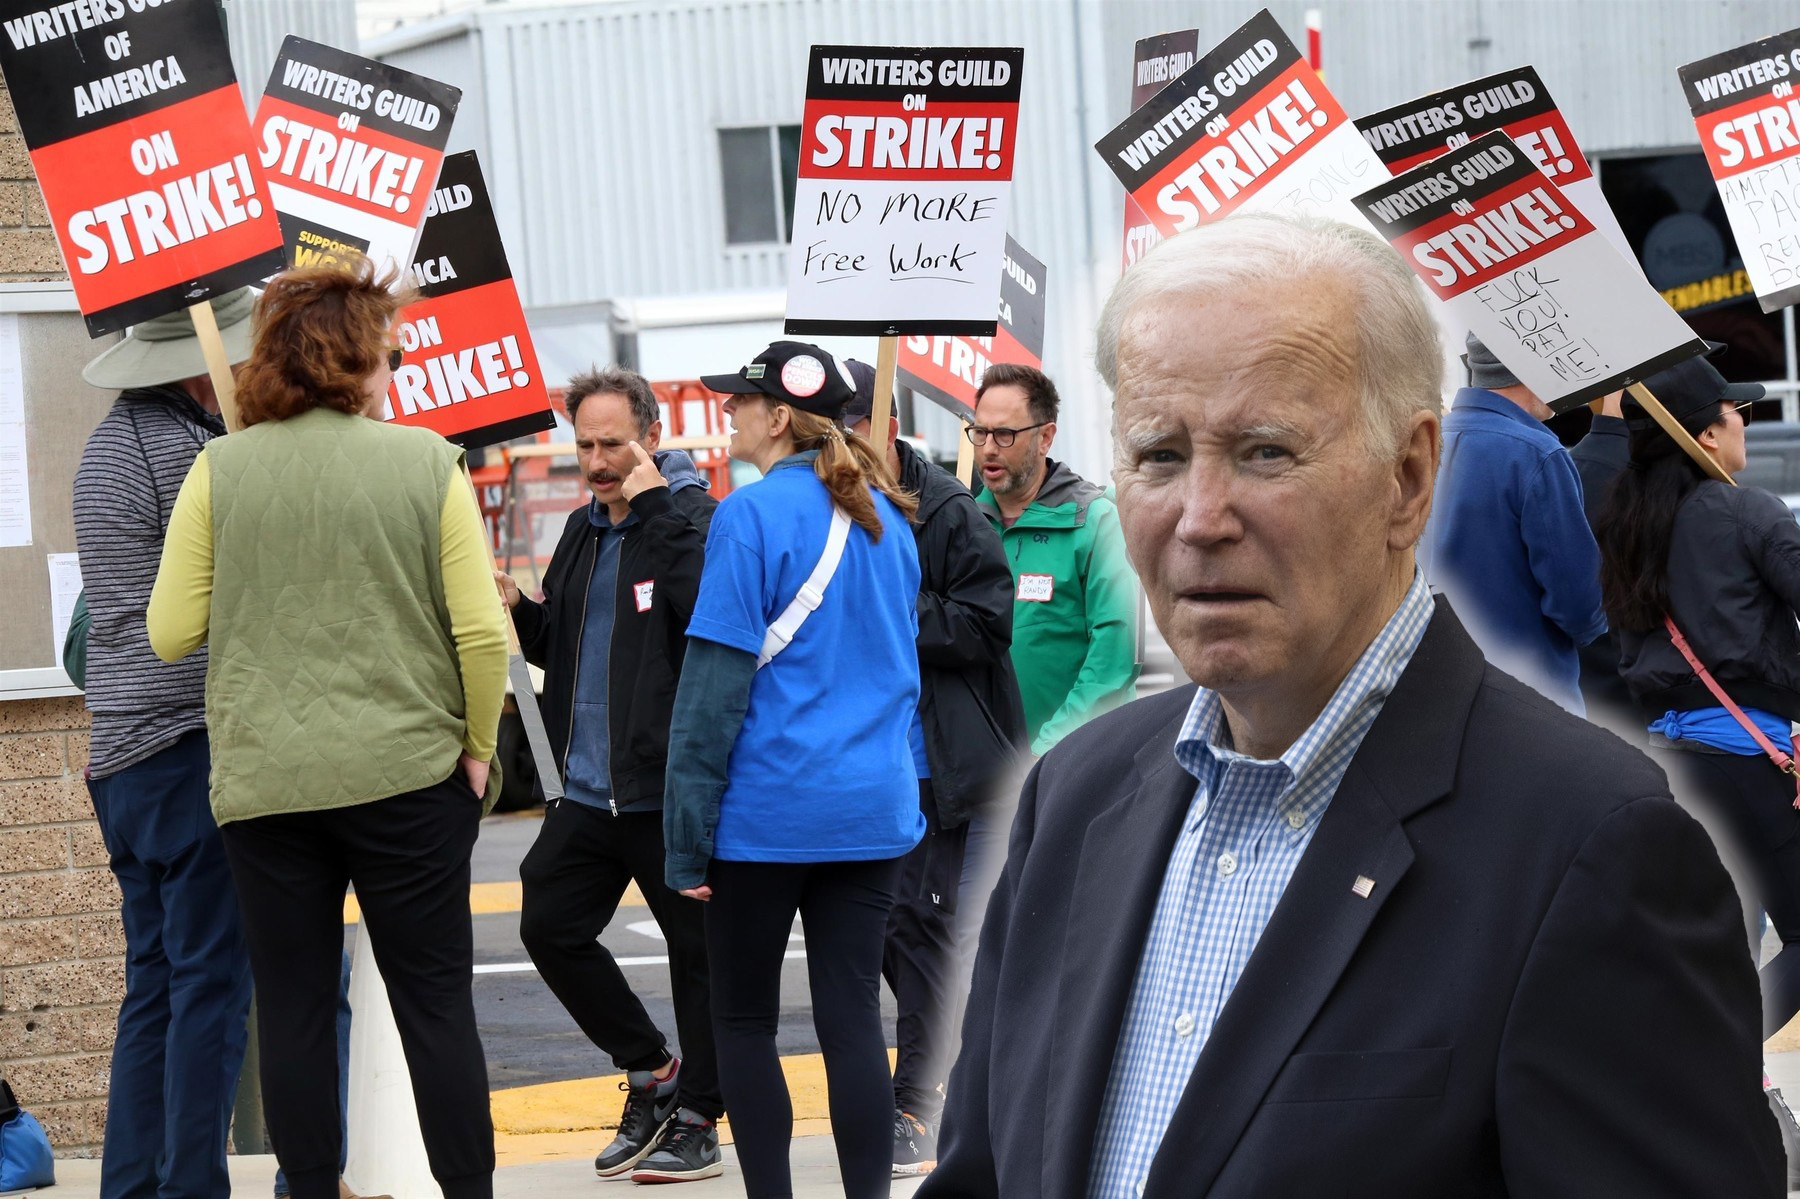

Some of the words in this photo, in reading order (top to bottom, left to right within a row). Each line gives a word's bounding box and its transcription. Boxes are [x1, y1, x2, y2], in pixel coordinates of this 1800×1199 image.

[3, 0, 125, 50] WRITERS
[104, 31, 131, 61] OF
[74, 55, 187, 119] AMERICA
[822, 57, 934, 87] WRITERS
[938, 59, 1011, 87] GUILD
[1137, 55, 1168, 86] WRITERS
[1169, 51, 1193, 80] GUILD
[1694, 54, 1790, 102] WRITERS
[1772, 81, 1793, 99] ON
[282, 59, 376, 110] WRITERS
[374, 88, 441, 132] GUILD
[902, 94, 926, 111] ON
[1118, 85, 1219, 172] WRITERS
[1213, 38, 1278, 97] GUILD
[1362, 101, 1463, 151] WRITERS
[1462, 79, 1536, 126] GUILD
[337, 111, 361, 133] ON
[812, 115, 1004, 170] STRIKE!
[1205, 113, 1230, 138] ON
[1446, 131, 1471, 150] ON
[131, 130, 179, 176] ON
[258, 115, 424, 215] STRIKE!
[1156, 78, 1329, 233] STRIKE!
[1368, 170, 1459, 225] WRITERS
[1451, 144, 1515, 187] GUILD
[68, 153, 263, 275] STRIKE!
[817, 190, 861, 225] NO
[880, 192, 997, 225] MORE
[1450, 198, 1475, 217] ON
[804, 240, 872, 276] Free
[890, 243, 976, 274] Work
[1413, 187, 1577, 288] STRIKE!
[1473, 267, 1560, 312] FUCK
[401, 316, 443, 352] ON
[1522, 323, 1568, 358] PAY
